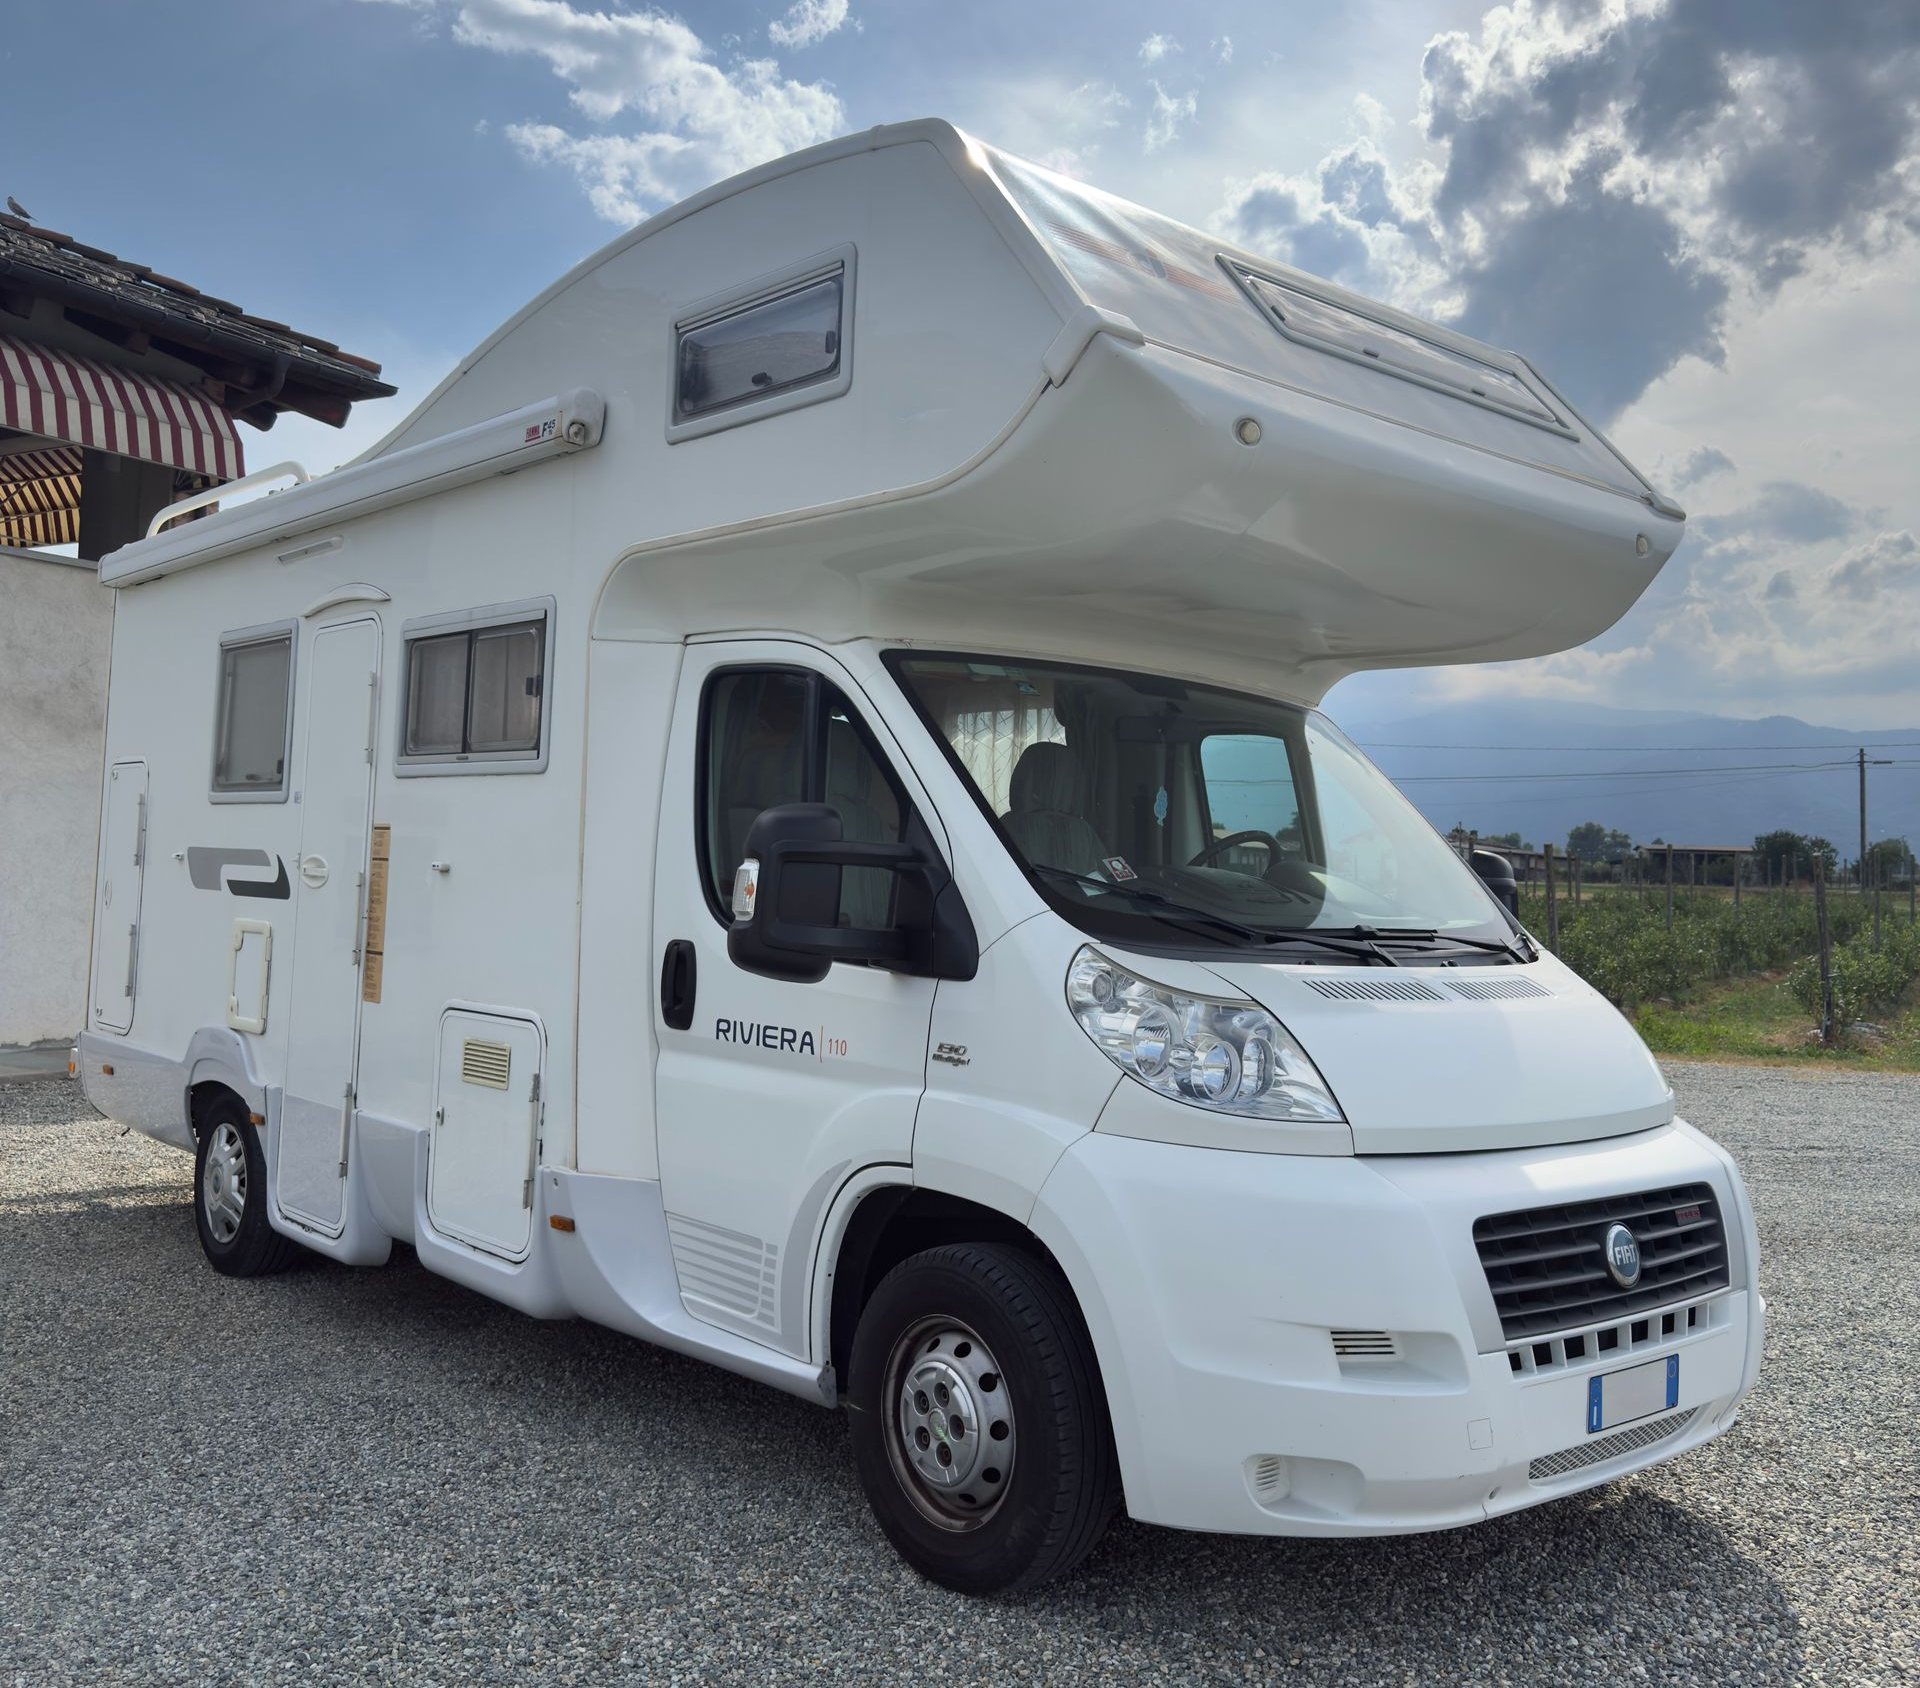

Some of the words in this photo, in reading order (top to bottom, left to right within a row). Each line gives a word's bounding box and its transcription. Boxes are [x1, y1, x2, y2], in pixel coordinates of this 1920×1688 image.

[715, 1017, 815, 1056] RIVIERA
[827, 1037, 848, 1056] 110
[1614, 1244, 1636, 1266] FIAT
